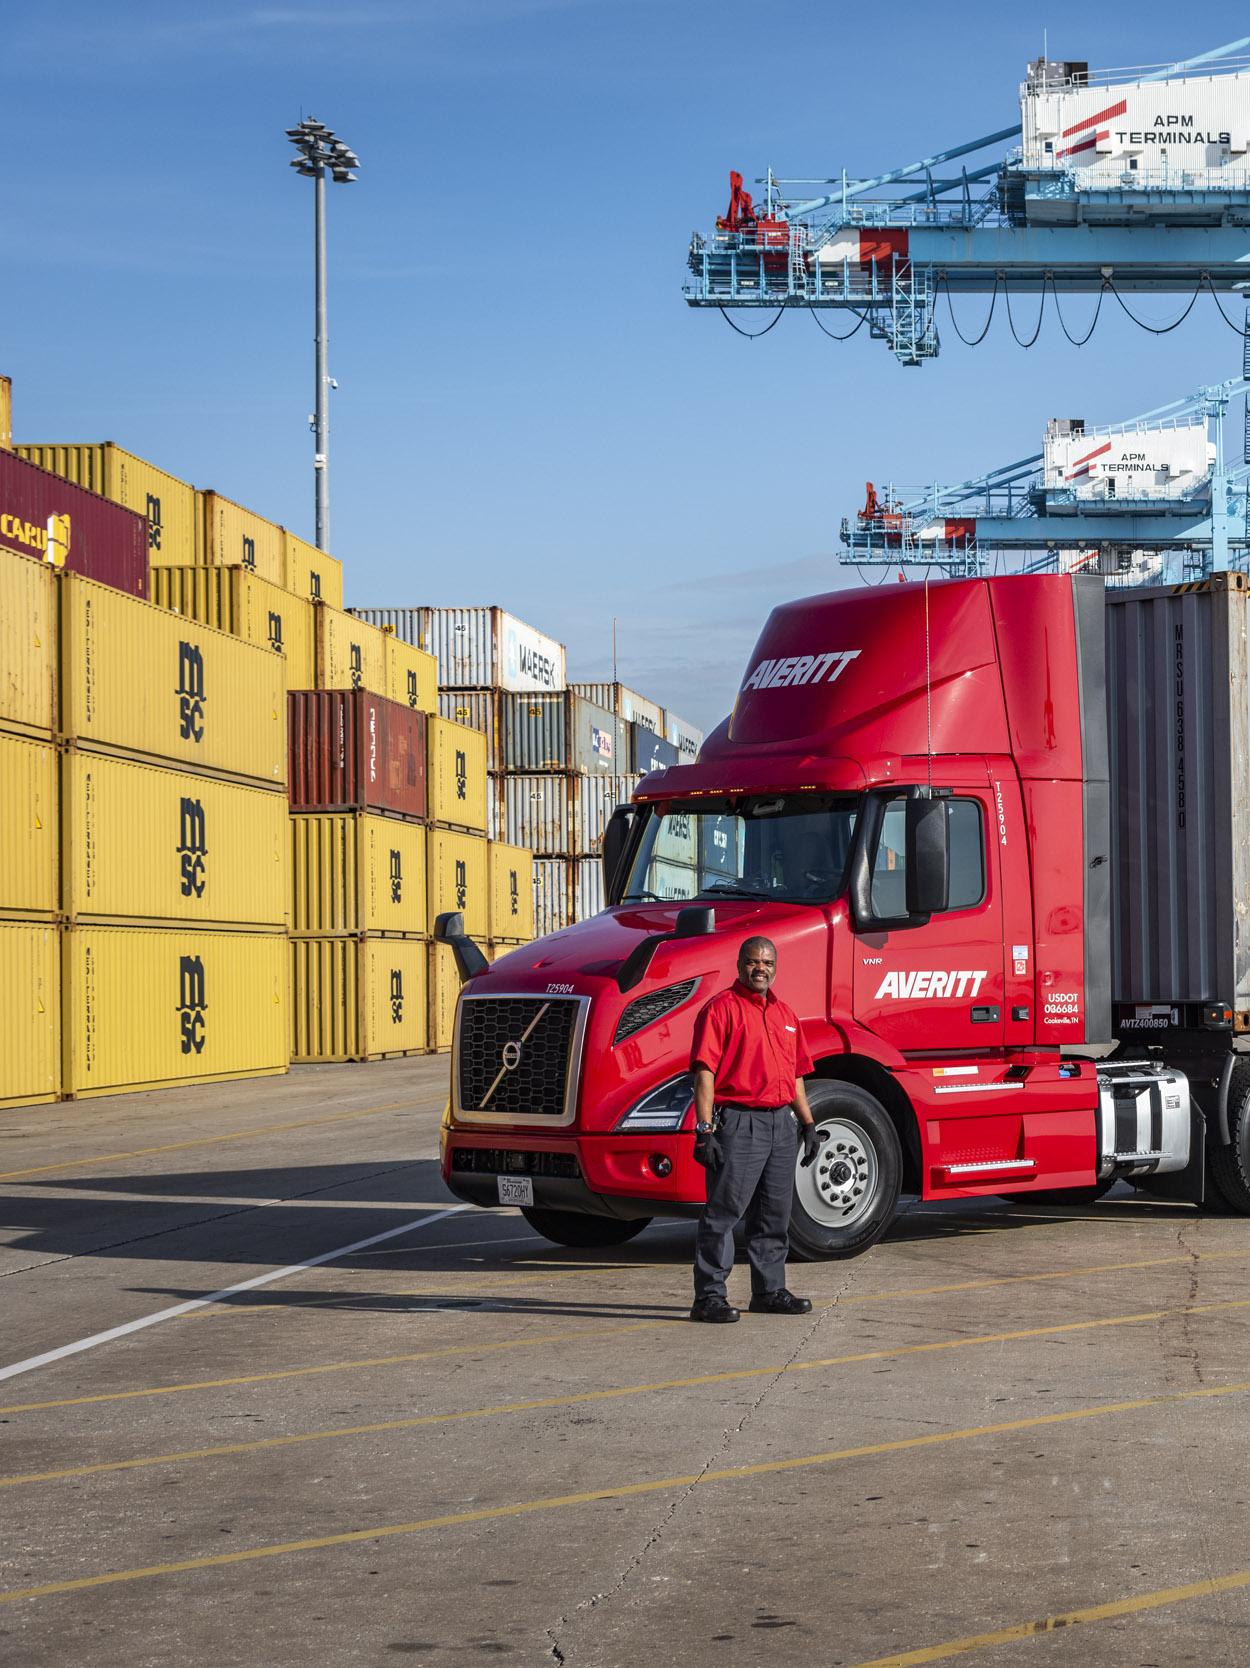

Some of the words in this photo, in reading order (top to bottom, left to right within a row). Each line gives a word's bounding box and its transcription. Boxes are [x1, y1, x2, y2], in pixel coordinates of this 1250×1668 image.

[1154, 115, 1194, 127] APM
[1115, 132, 1231, 144] TERMINALS
[1121, 453, 1146, 461] APM
[1103, 463, 1169, 472] TERMINALS
[455, 624, 466, 632] 45
[520, 643, 555, 689] MAERSK
[1175, 624, 1184, 697] MRSU
[743, 649, 862, 691] AVERITT
[530, 792, 542, 800] 45
[995, 782, 1007, 845] T25904
[546, 983, 574, 994] T25904
[874, 970, 988, 999] AVERITT
[1048, 993, 1078, 1002] USDOT
[1044, 1004, 1079, 1014] 036684
[1120, 1018, 1169, 1029] AVTZ400850
